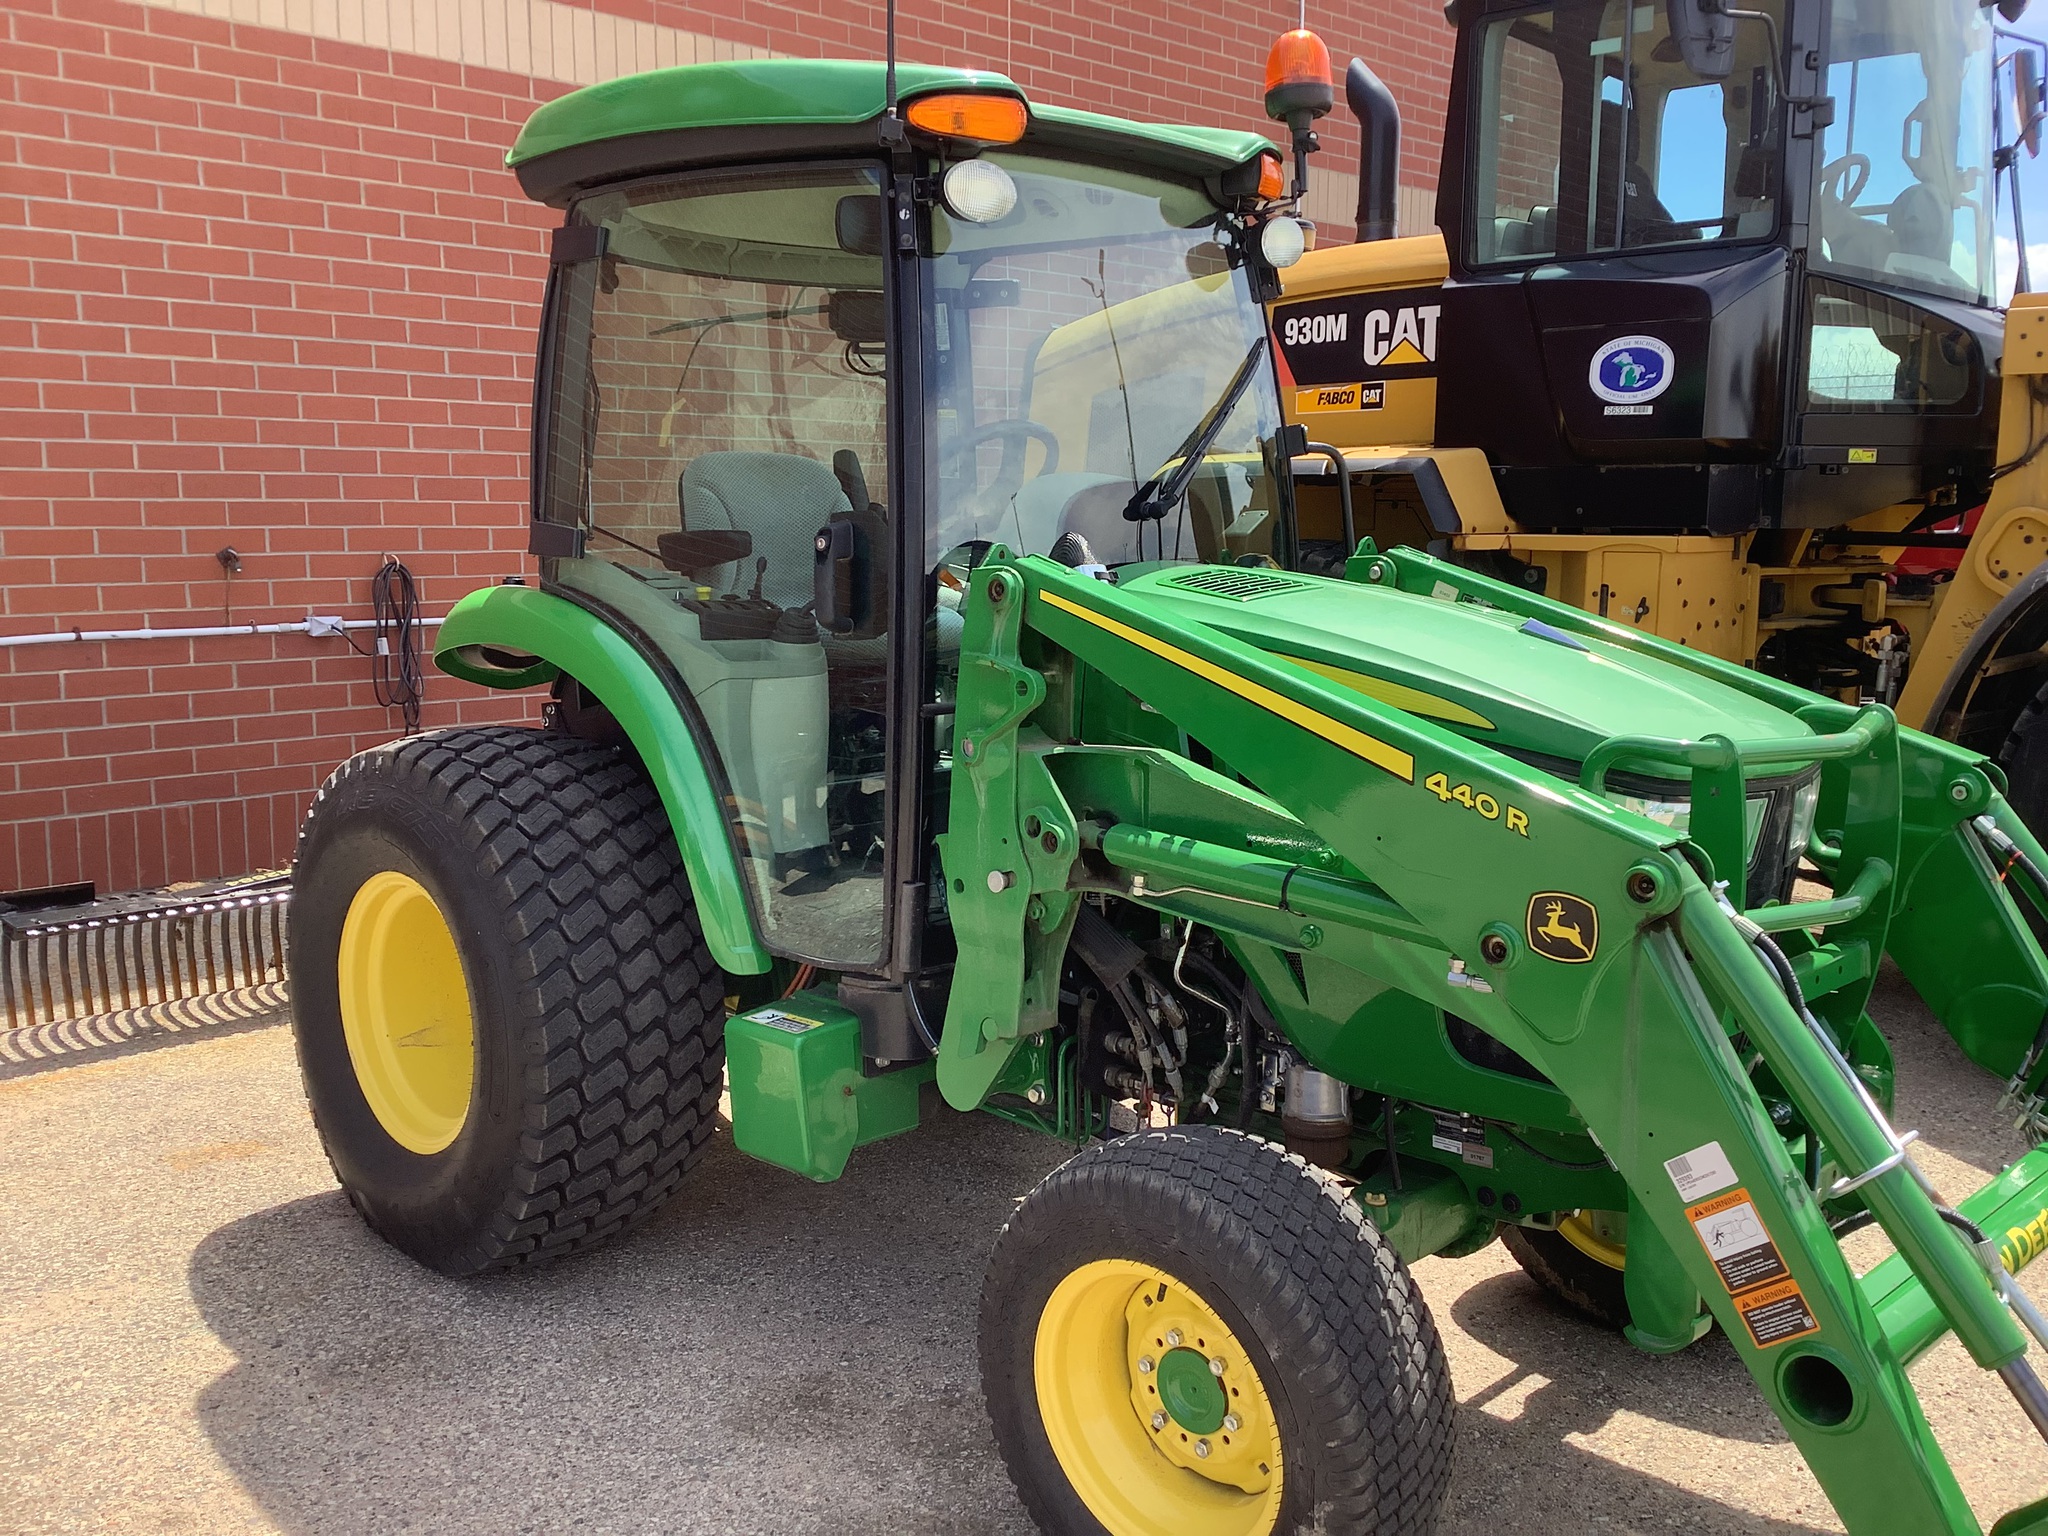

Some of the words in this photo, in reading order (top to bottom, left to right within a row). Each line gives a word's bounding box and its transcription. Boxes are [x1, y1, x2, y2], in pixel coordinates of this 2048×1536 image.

[1285, 313, 1348, 346] 930M
[1363, 305, 1441, 366] CAT
[1602, 343, 1621, 355] STATE
[1634, 340, 1665, 353] MICHIGAN
[1317, 390, 1355, 405] FABCO
[1362, 389, 1382, 404] CAT
[1425, 772, 1500, 820] 440
[1506, 804, 1530, 838] R
[1702, 1193, 1742, 1213] WARNING
[1752, 1285, 1792, 1304] WARNING
